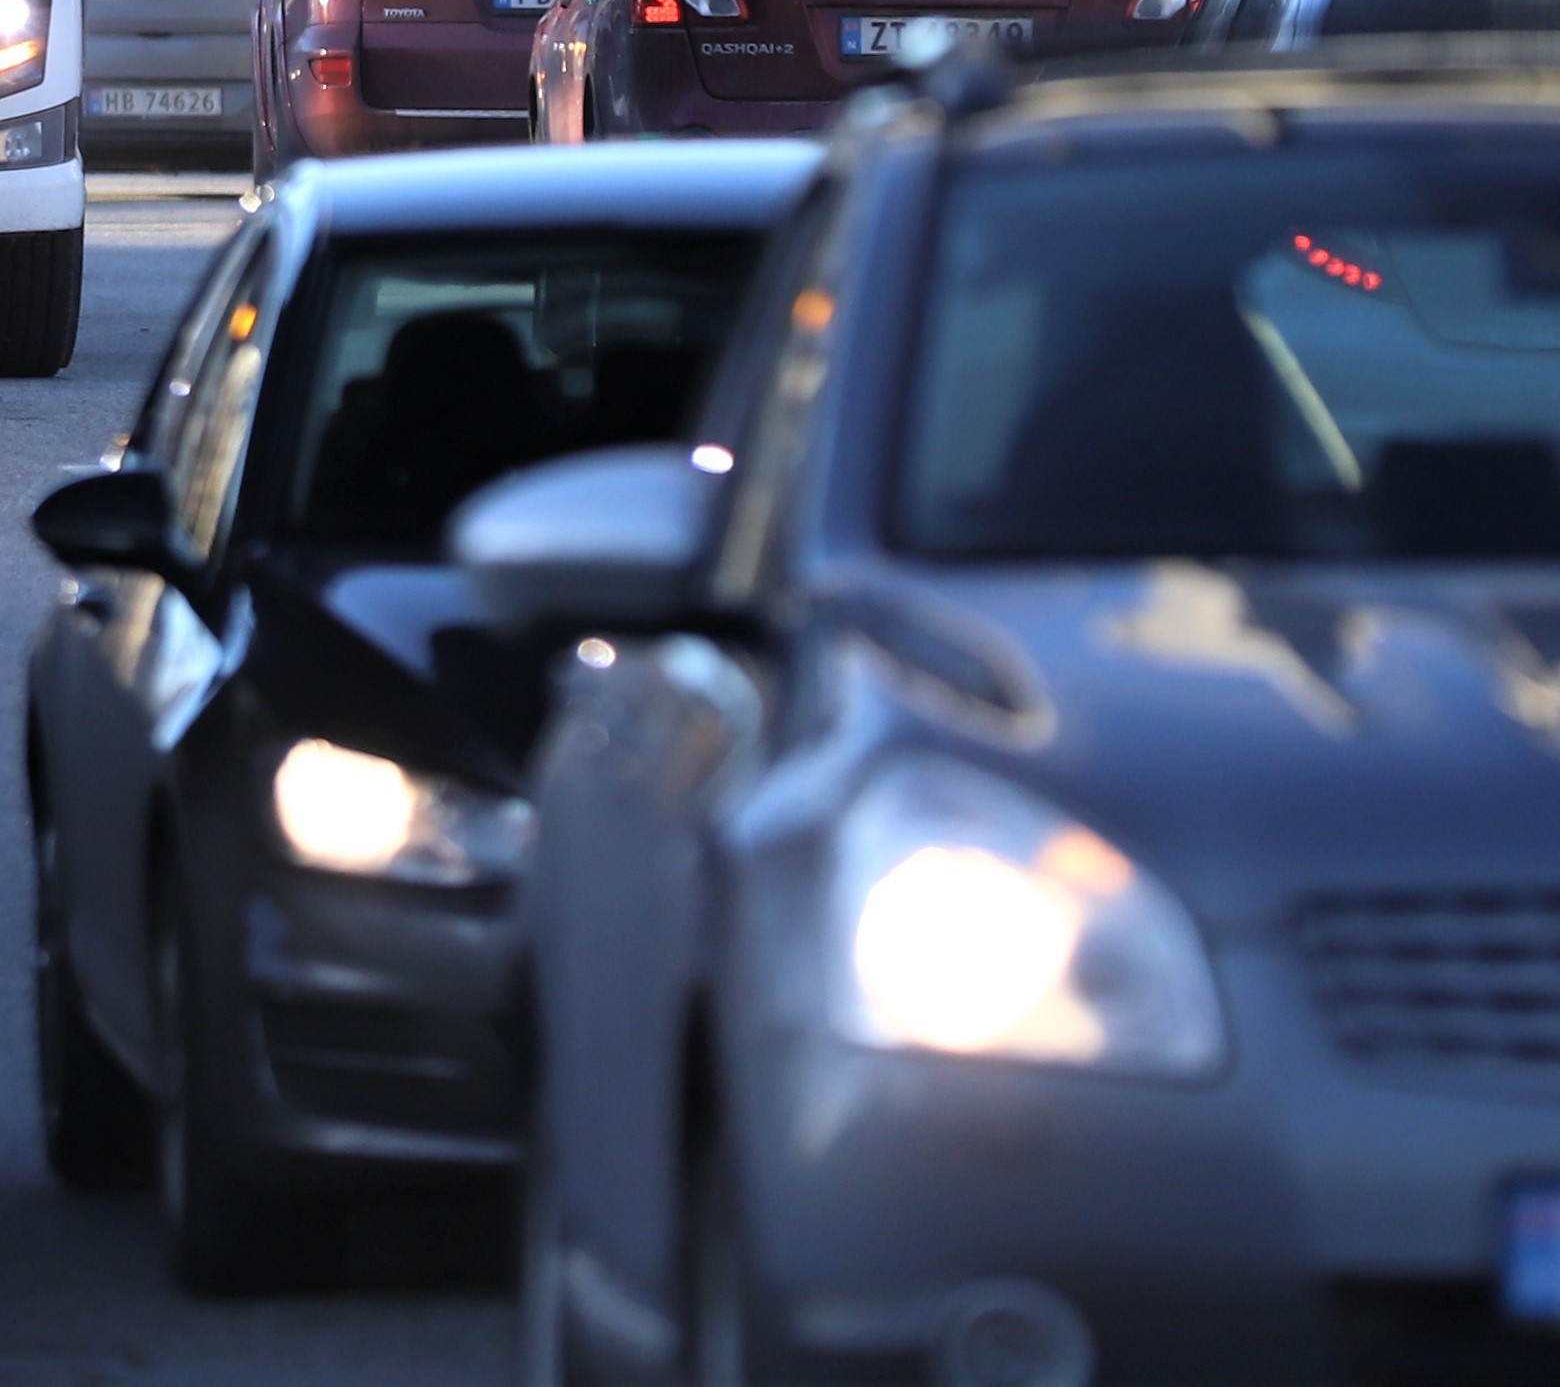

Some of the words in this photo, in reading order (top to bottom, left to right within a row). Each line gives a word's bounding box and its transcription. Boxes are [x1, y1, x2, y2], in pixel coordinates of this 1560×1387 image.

[383, 7, 426, 18] TOYOTA
[701, 42, 795, 56] QASHQAI+2
[105, 91, 134, 113] HB
[145, 90, 215, 114] 74626
